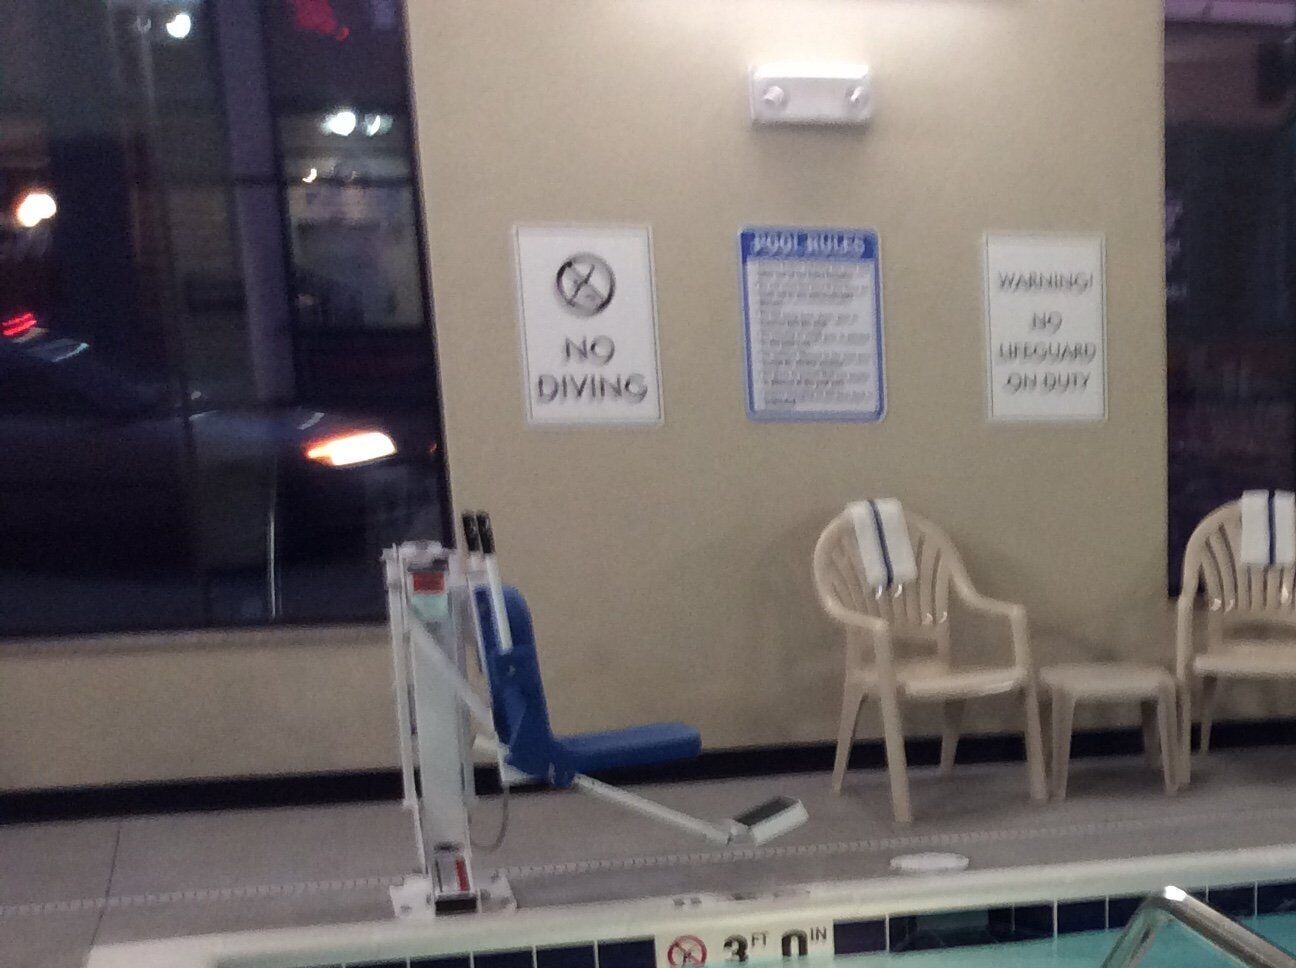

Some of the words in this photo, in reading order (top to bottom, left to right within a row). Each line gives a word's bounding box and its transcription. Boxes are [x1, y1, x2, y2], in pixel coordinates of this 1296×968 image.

[754, 231, 799, 254] POOL
[807, 232, 865, 257] RULES
[1031, 310, 1063, 336] NO
[564, 334, 616, 367] NO
[999, 341, 1096, 365] LIFEGUARD
[537, 373, 648, 405] DIVING
[1005, 370, 1037, 395] ON
[1043, 370, 1091, 394] DUTY
